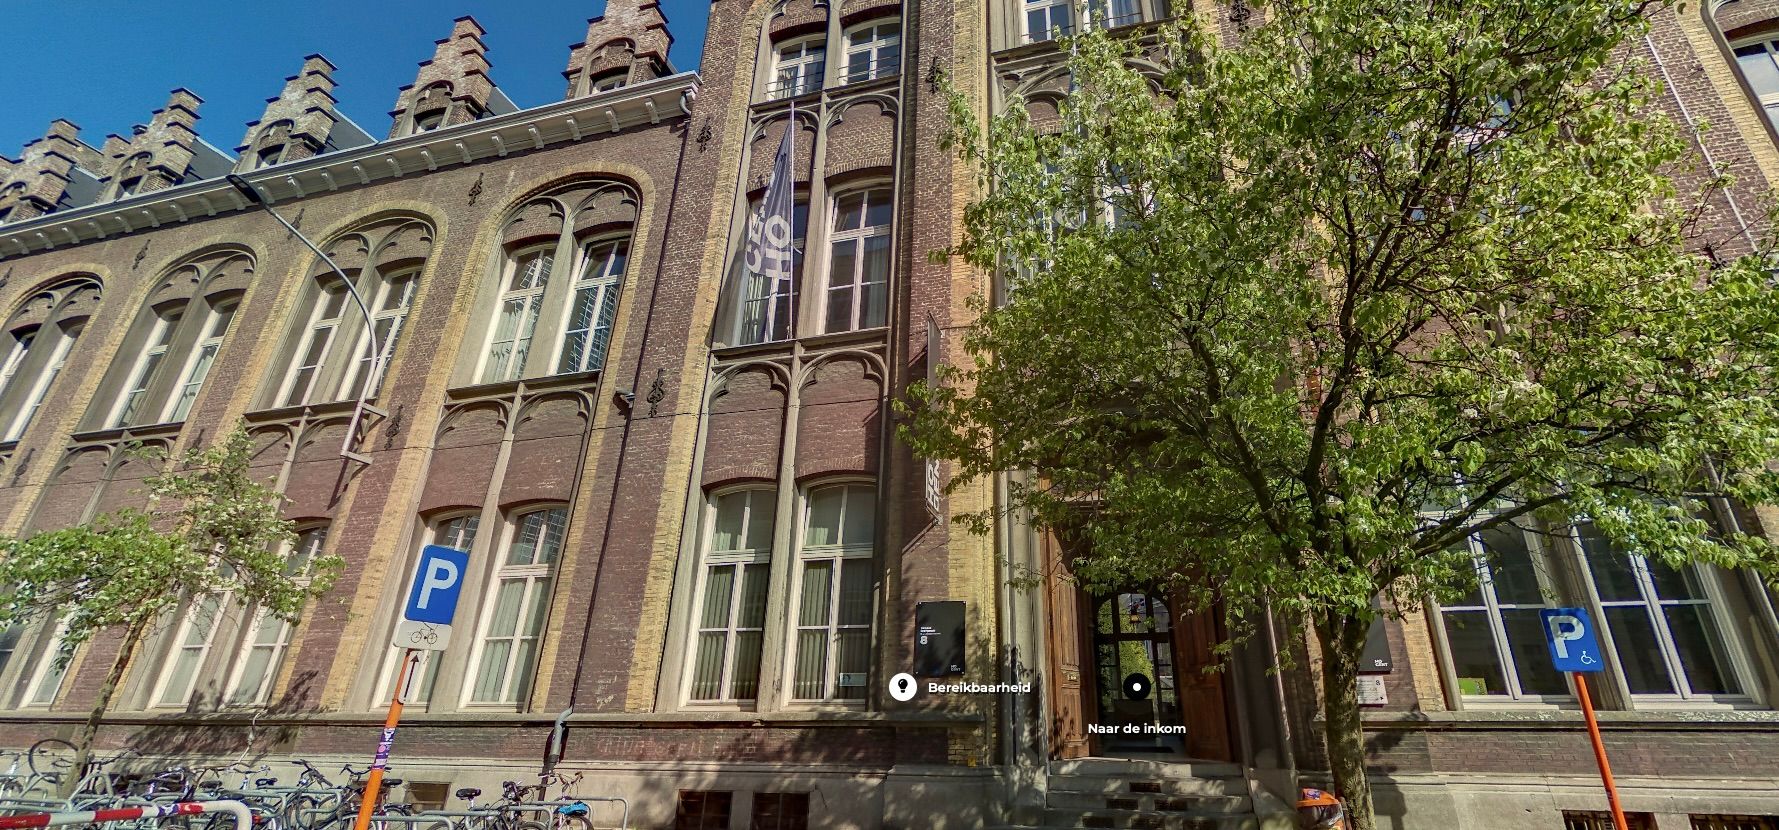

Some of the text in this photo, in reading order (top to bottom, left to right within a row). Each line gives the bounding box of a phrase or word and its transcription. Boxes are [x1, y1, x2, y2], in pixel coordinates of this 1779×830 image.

[417, 557, 458, 610] P
[920, 636, 928, 645] 8
[1547, 615, 1585, 659] P
